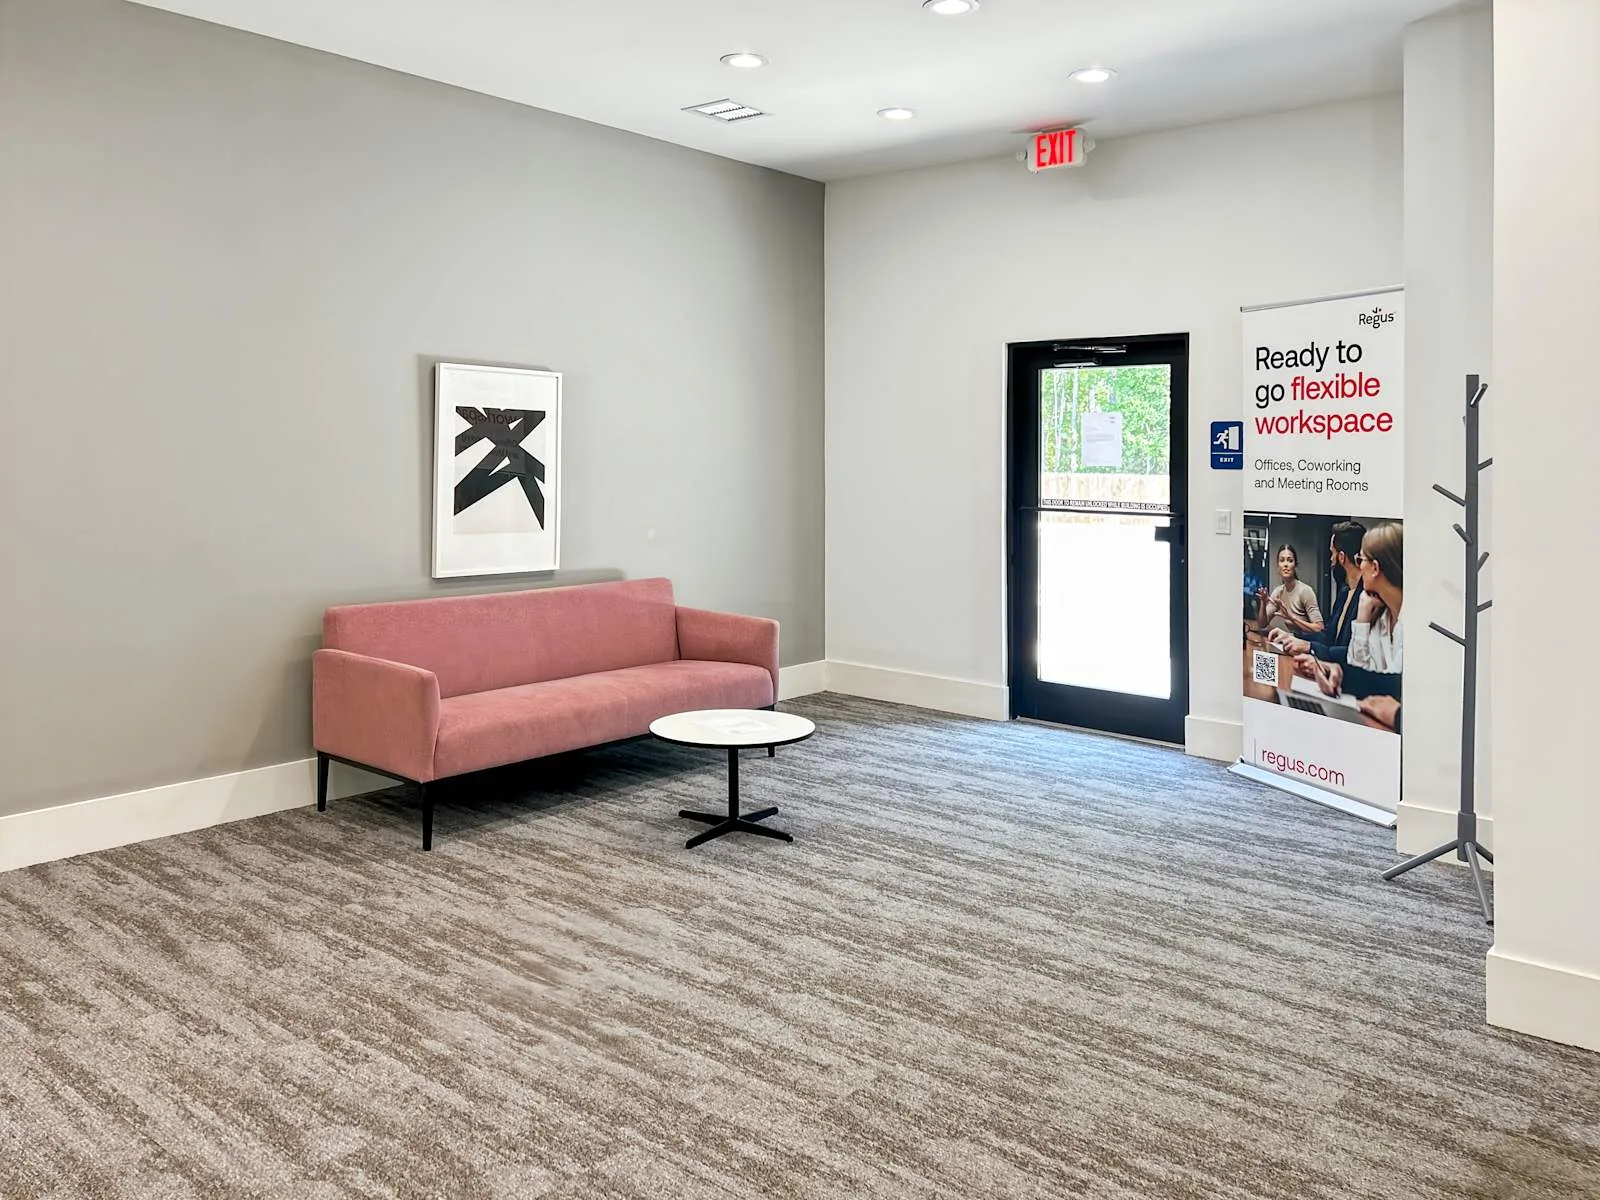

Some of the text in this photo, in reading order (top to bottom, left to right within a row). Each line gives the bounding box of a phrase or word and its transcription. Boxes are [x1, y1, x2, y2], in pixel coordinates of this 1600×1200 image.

[1036, 129, 1077, 168] EXIT
[1359, 307, 1394, 328] Regus
[1256, 340, 1362, 372] Ready to
[1255, 372, 1380, 409] go flexible
[1255, 409, 1393, 440] workspace
[1254, 459, 1361, 475] Offices, Coworking
[1254, 477, 1369, 493] and Meeting Rooms
[1262, 749, 1345, 787] regus.com
